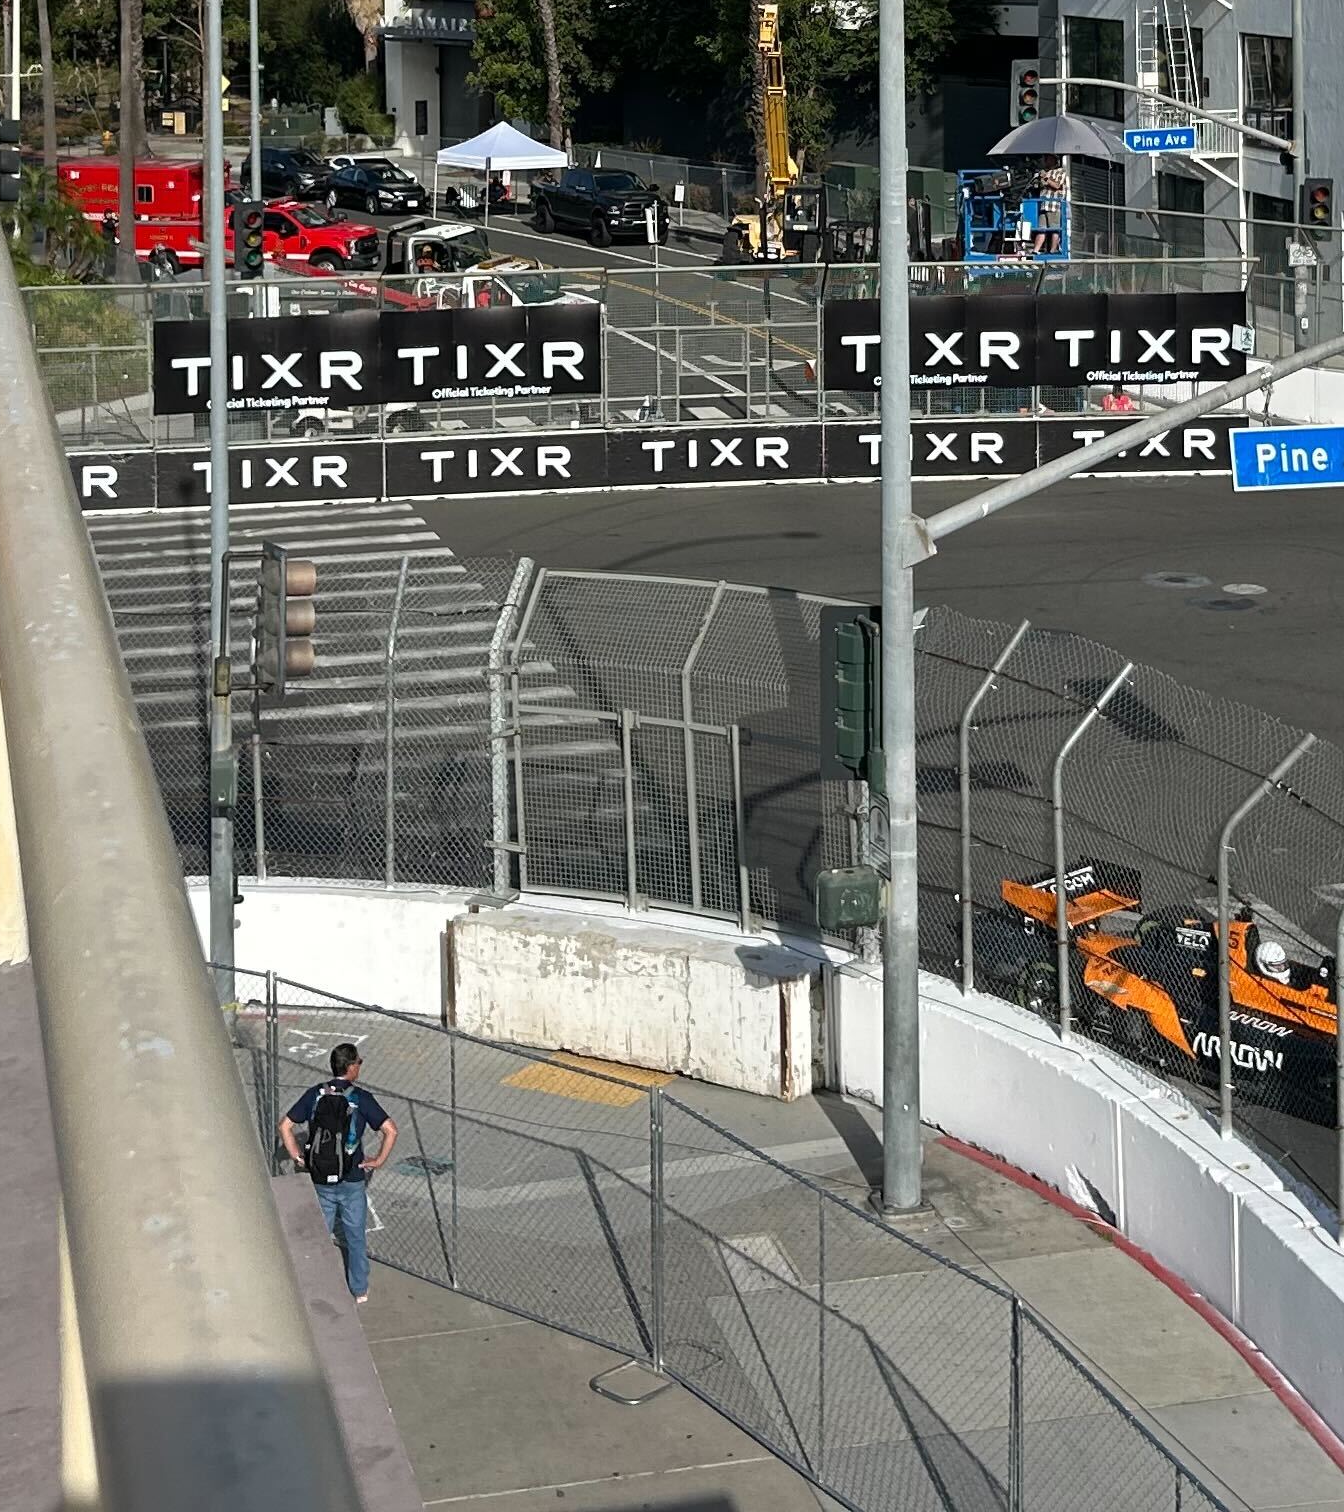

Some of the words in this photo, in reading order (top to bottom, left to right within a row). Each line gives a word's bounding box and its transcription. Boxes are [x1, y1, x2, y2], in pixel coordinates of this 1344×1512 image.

[1133, 134, 1161, 147] Pine
[1164, 133, 1187, 146] Ave
[397, 341, 585, 386] TIXR
[840, 331, 1021, 373] TXR
[1054, 327, 1231, 368] TIXR
[171, 350, 364, 397] TIXR
[953, 373, 988, 384] Partner
[1086, 370, 1121, 382] Official
[1122, 370, 1164, 382] Ticketing
[1164, 370, 1199, 381] Partner
[246, 396, 292, 409] Ticketing
[292, 395, 330, 406] Partner
[432, 387, 469, 399] Official
[469, 385, 514, 398] Ticketing
[514, 384, 552, 396] Partner
[641, 436, 789, 472] TIXR
[1072, 428, 1216, 460] TXR
[1256, 442, 1329, 473] Pine
[420, 445, 572, 483] TIXR
